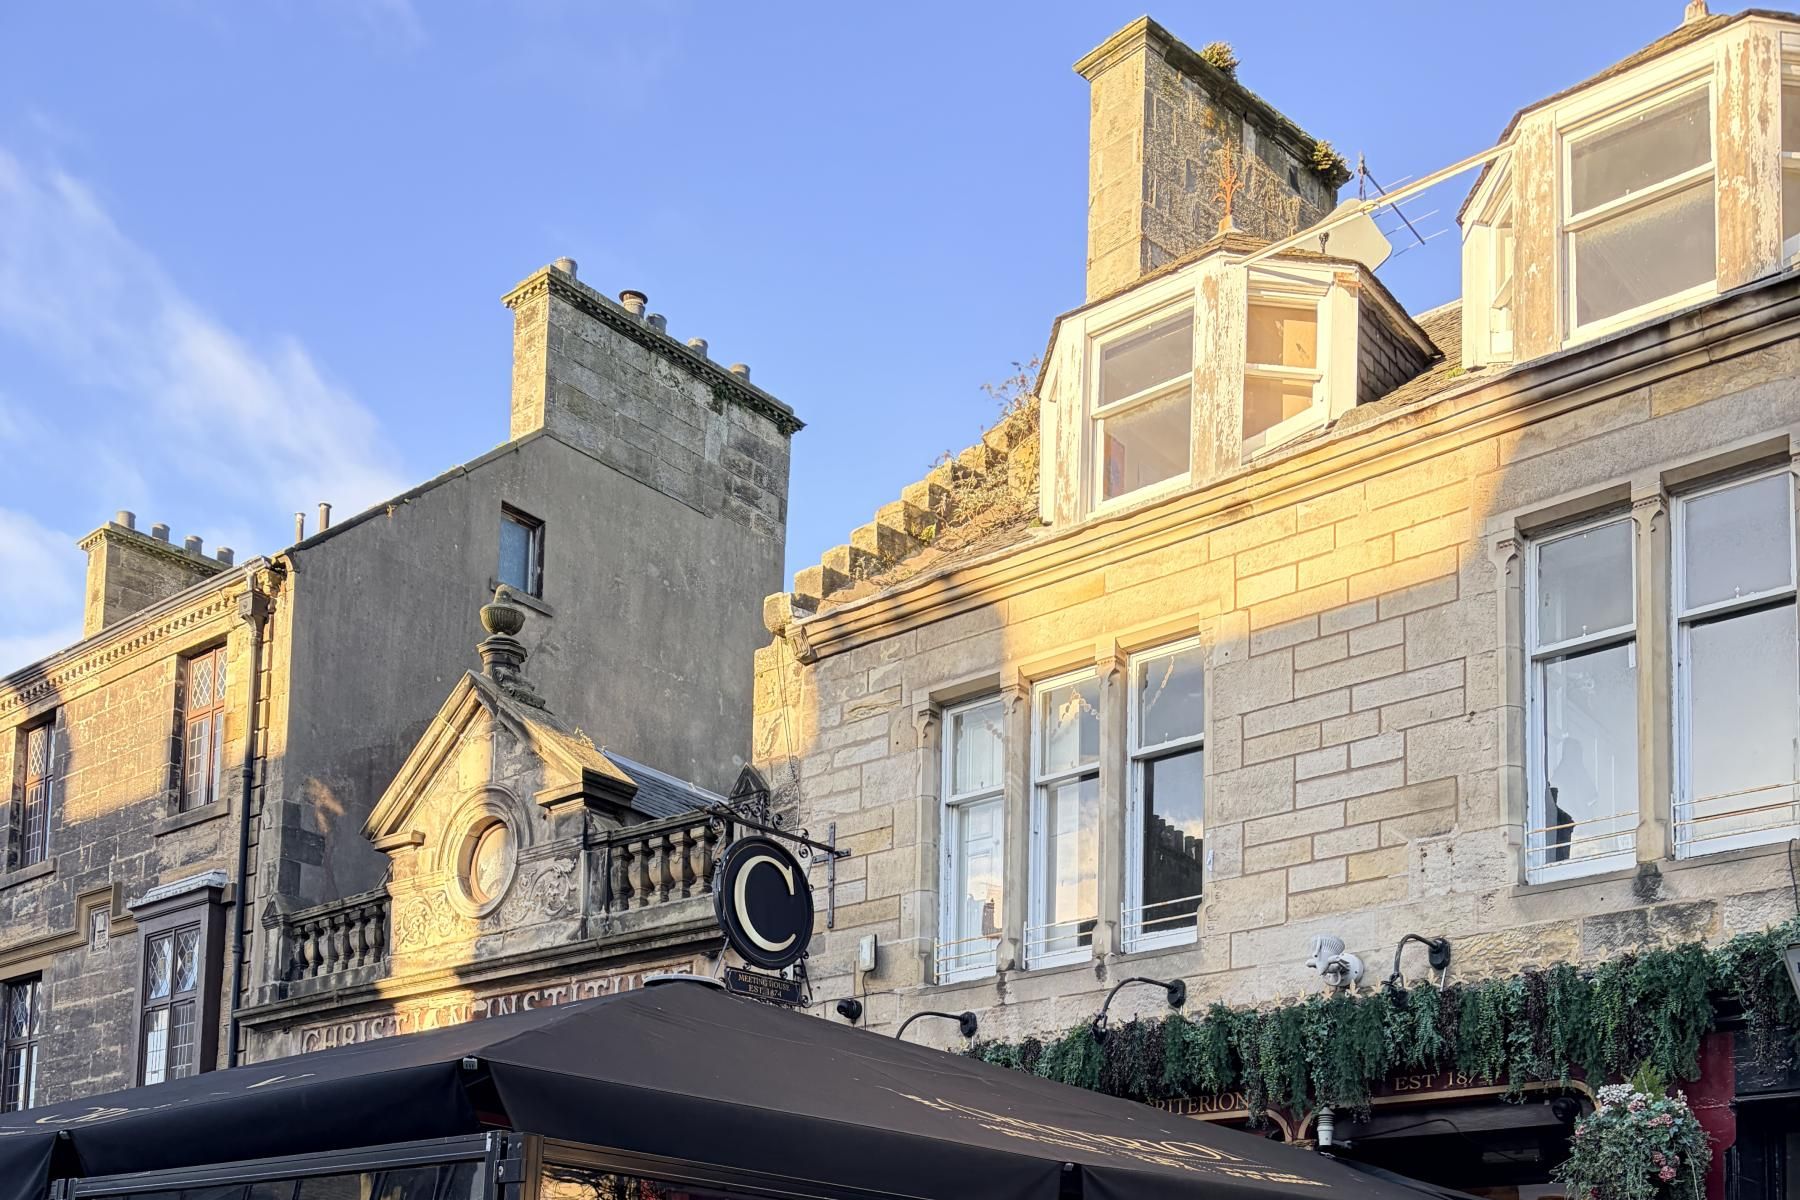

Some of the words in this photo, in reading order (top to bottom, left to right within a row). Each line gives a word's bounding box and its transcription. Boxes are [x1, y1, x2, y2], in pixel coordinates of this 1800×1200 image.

[734, 855, 797, 952] C
[486, 965, 694, 1018] INSTITU
[739, 974, 768, 986] MEETING
[769, 980, 791, 992] HOUSE
[1395, 1074, 1436, 1091] EST
[1146, 1092, 1249, 1115] RITERION
